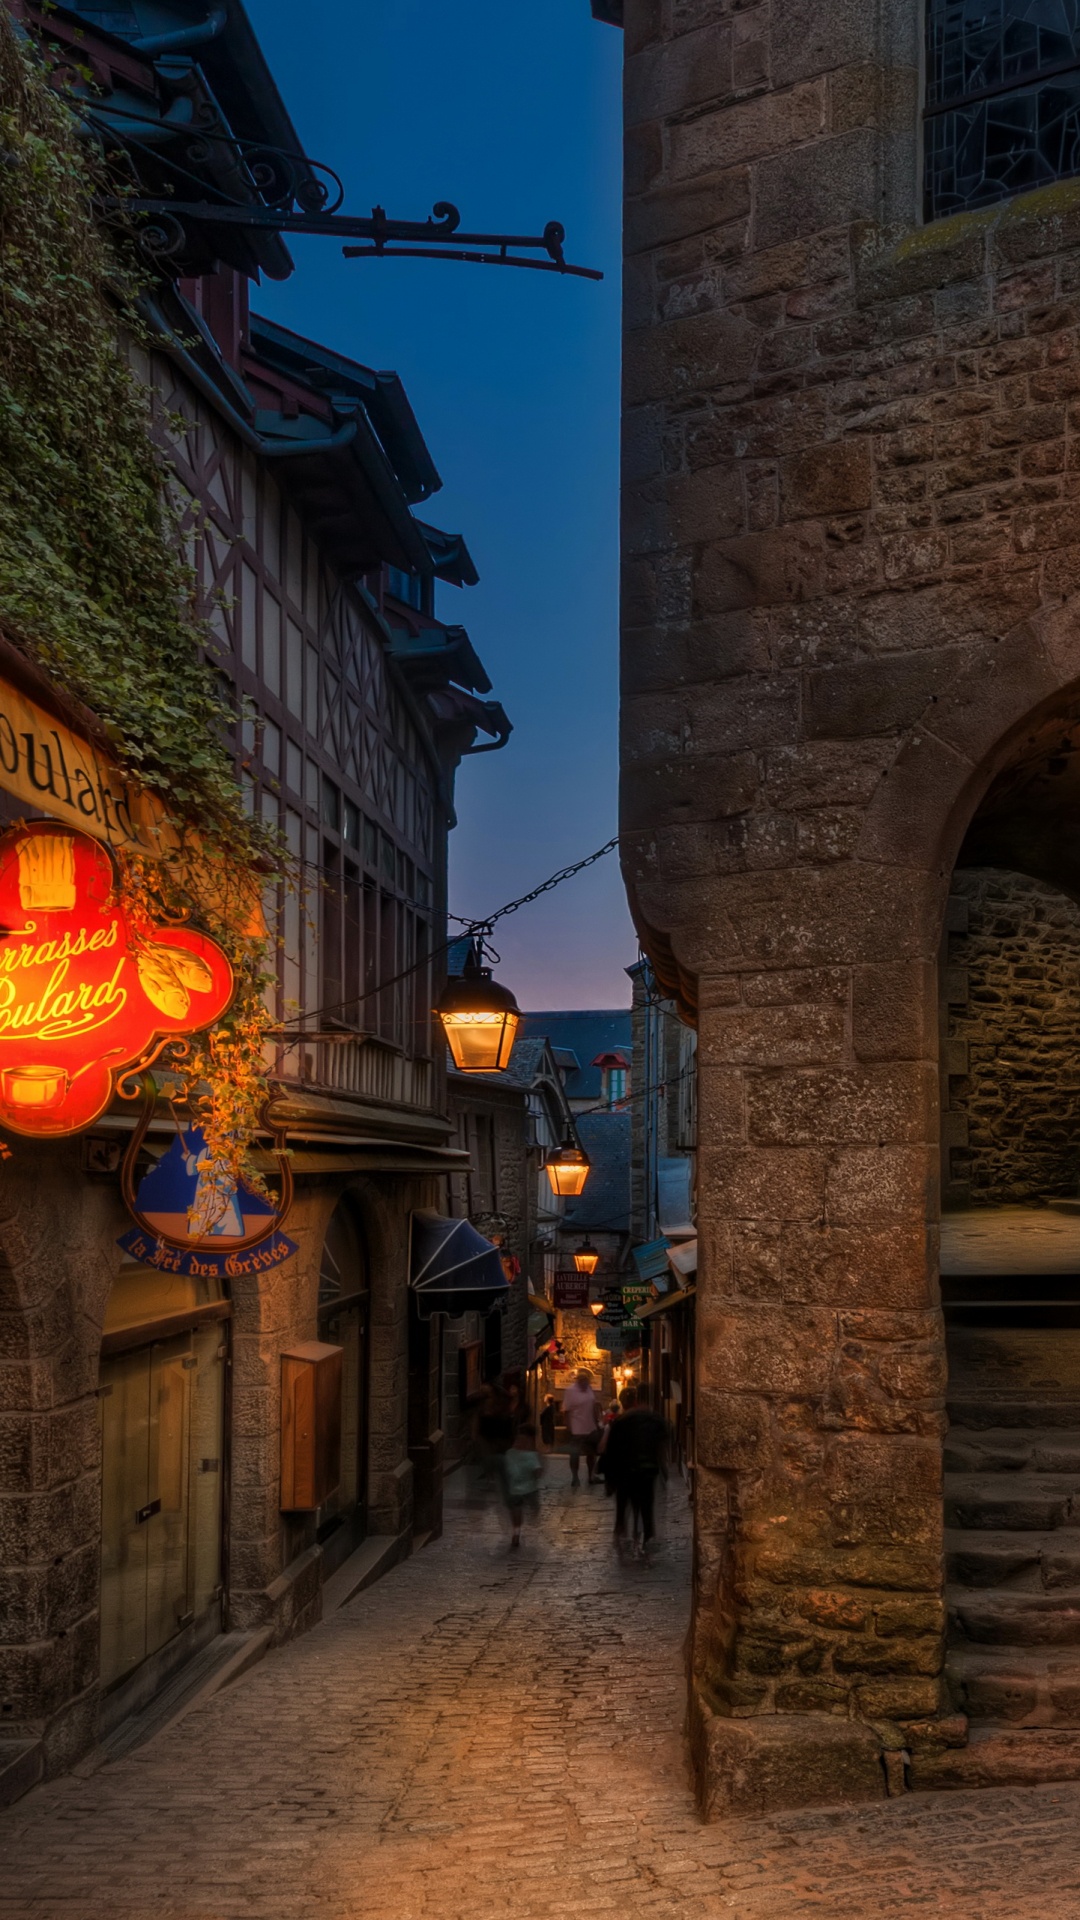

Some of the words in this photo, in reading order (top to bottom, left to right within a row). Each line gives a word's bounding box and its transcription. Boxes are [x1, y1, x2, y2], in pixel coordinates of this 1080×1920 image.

[0, 920, 118, 972] rrasses
[189, 1255, 220, 1276] des
[224, 1241, 290, 1277] Grèves
[556, 1282, 588, 1290] AUBERGE
[622, 1286, 652, 1294] CREPERI
[622, 1320, 639, 1328] BAR
